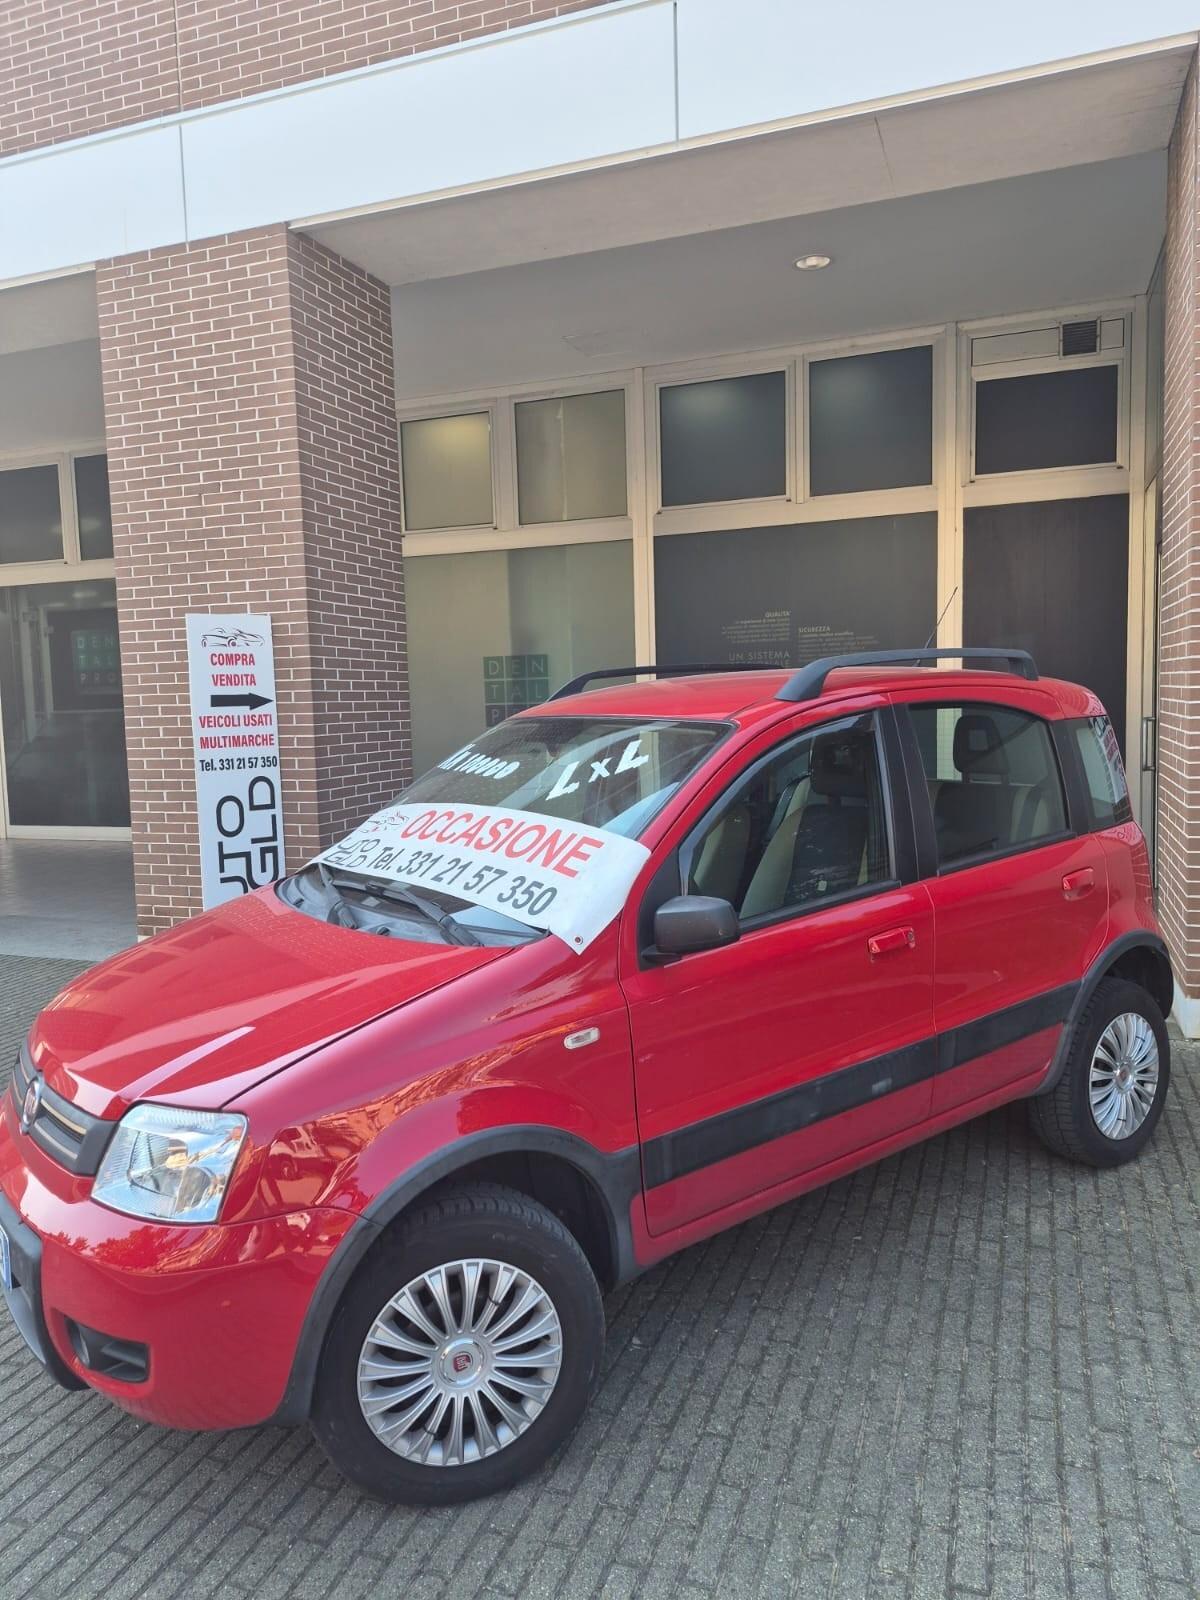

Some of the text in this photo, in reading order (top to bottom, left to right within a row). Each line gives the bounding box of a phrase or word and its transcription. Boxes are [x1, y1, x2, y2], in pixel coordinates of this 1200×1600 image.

[210, 653, 256, 667] COMPRA
[747, 649, 791, 661] SISTEMA
[211, 673, 257, 687] VENDITA
[199, 714, 273, 729] VEICOLI USATI
[200, 734, 275, 750] MULTIMARCHE
[199, 756, 278, 772] Tel. 331 21 57 350
[401, 809, 605, 878] OCCASIONE
[366, 846, 558, 916] Tel. 331 21 57 350
